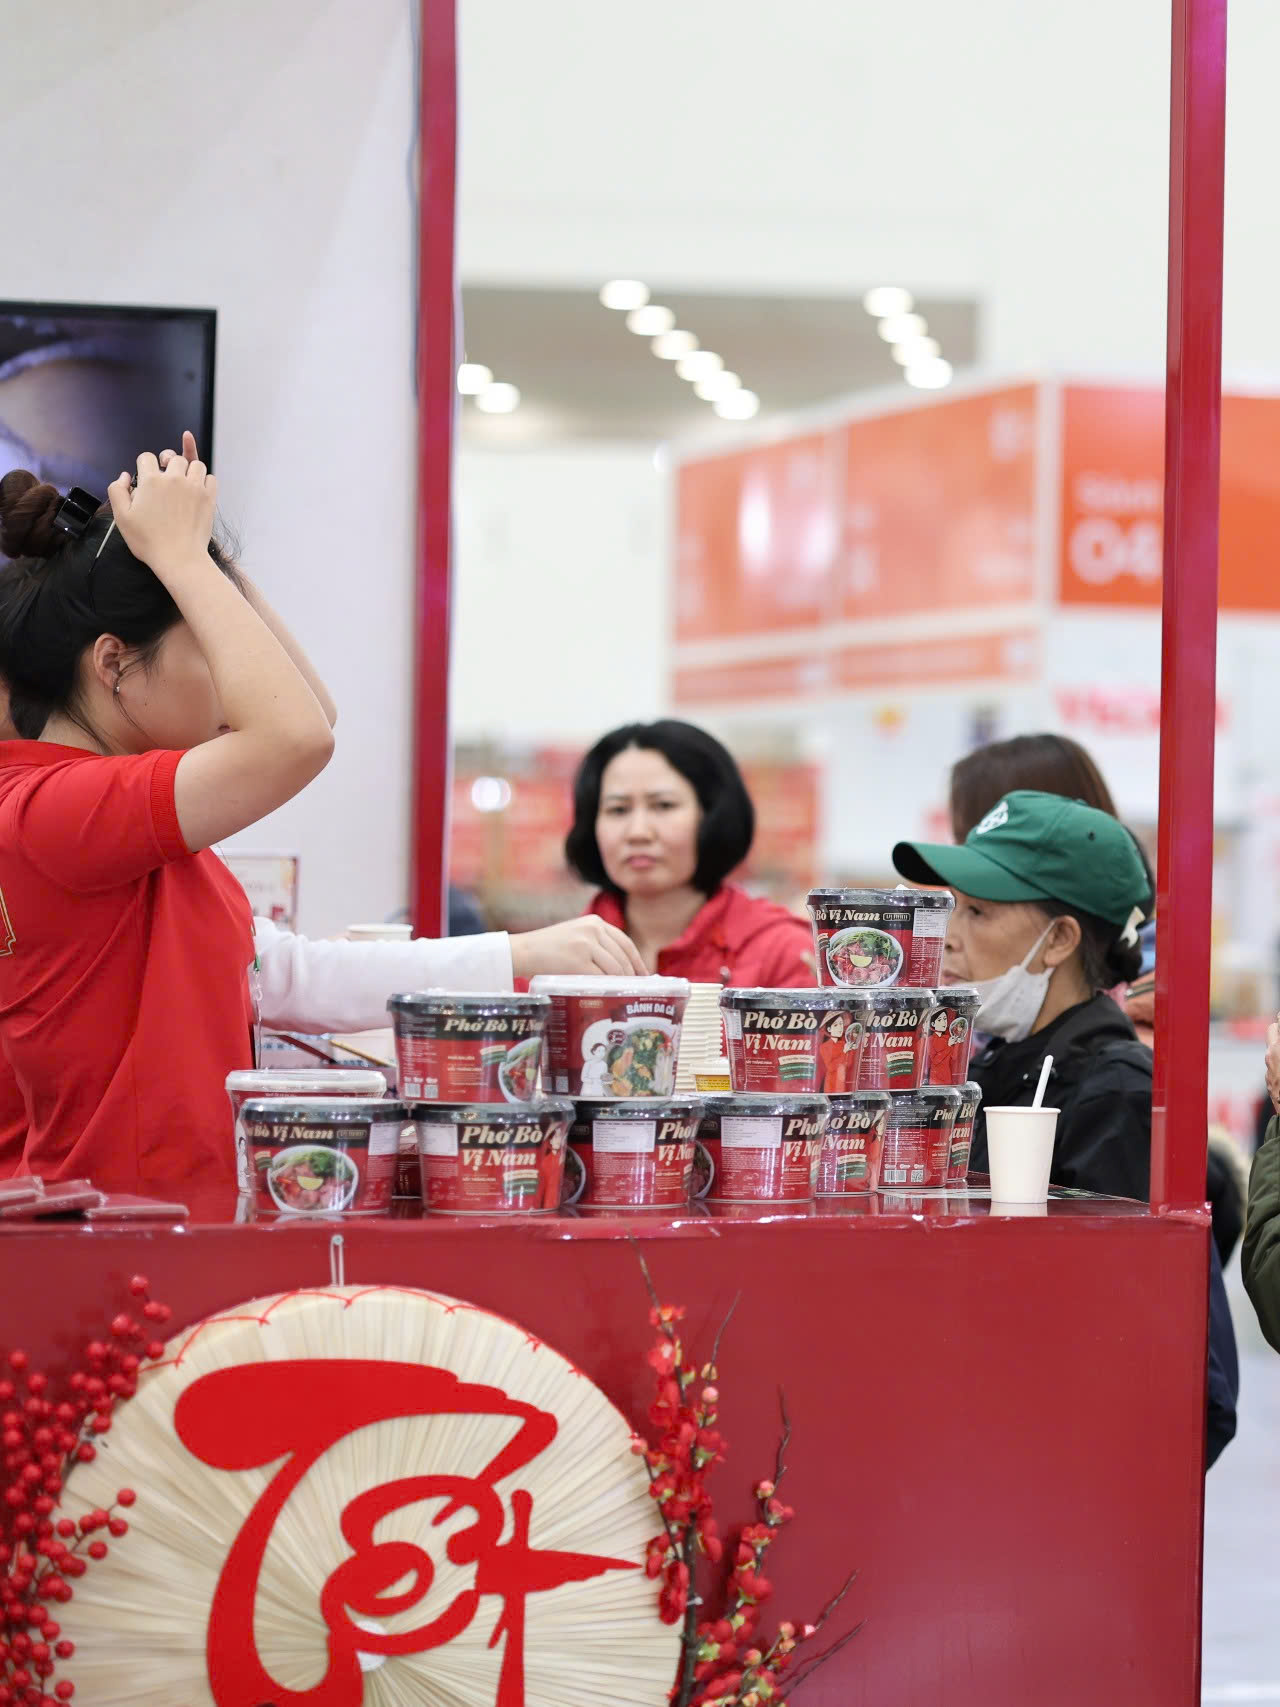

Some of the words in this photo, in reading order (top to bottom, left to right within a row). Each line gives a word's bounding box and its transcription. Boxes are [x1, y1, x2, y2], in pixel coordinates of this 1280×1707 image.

[829, 909, 841, 924] Vị
[843, 909, 880, 921] Nam
[444, 1017, 484, 1032] Phở
[484, 1018, 508, 1032] Bò
[511, 1019, 526, 1035] Vị
[744, 1010, 787, 1030] Phở
[787, 1011, 818, 1030] Bò
[866, 1008, 897, 1027] hở
[895, 1009, 918, 1027] Bò
[744, 1034, 762, 1054] Vị
[763, 1034, 811, 1051] Nam
[871, 1033, 913, 1048] Nam
[846, 1111, 871, 1129] Bò
[272, 1125, 288, 1142] Vị
[289, 1126, 334, 1140] Nam
[461, 1124, 513, 1144] Phở
[513, 1125, 543, 1144] Bò
[822, 1134, 866, 1150] Nam
[462, 1150, 485, 1171] Vị
[485, 1150, 537, 1167] Nam
[658, 1144, 676, 1167] Vị
[784, 1141, 802, 1162] Vị
